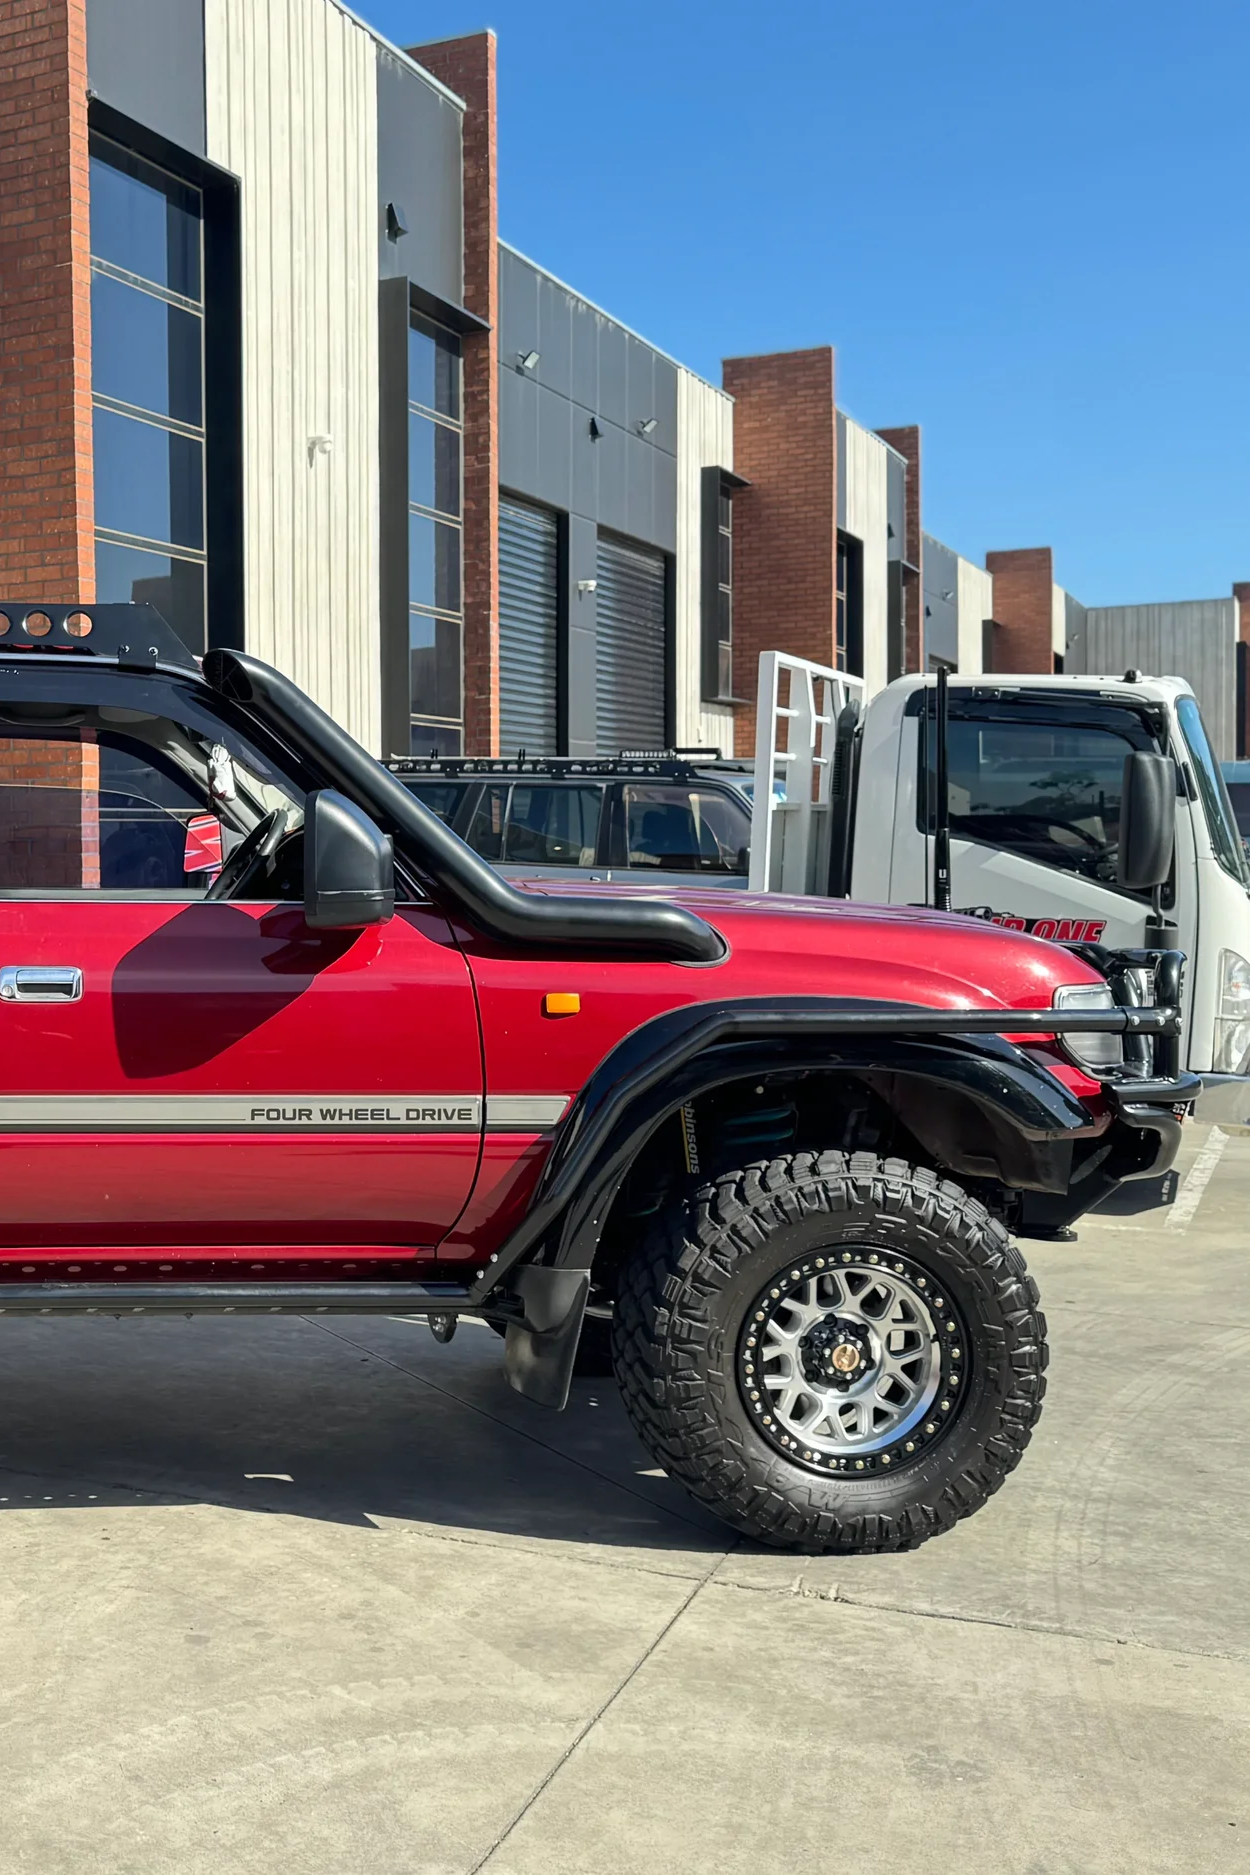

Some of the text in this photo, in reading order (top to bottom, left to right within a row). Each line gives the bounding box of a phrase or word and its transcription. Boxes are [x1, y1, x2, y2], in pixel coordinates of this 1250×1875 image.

[250, 1108, 473, 1121] FOUR WHEEL DRIVE
